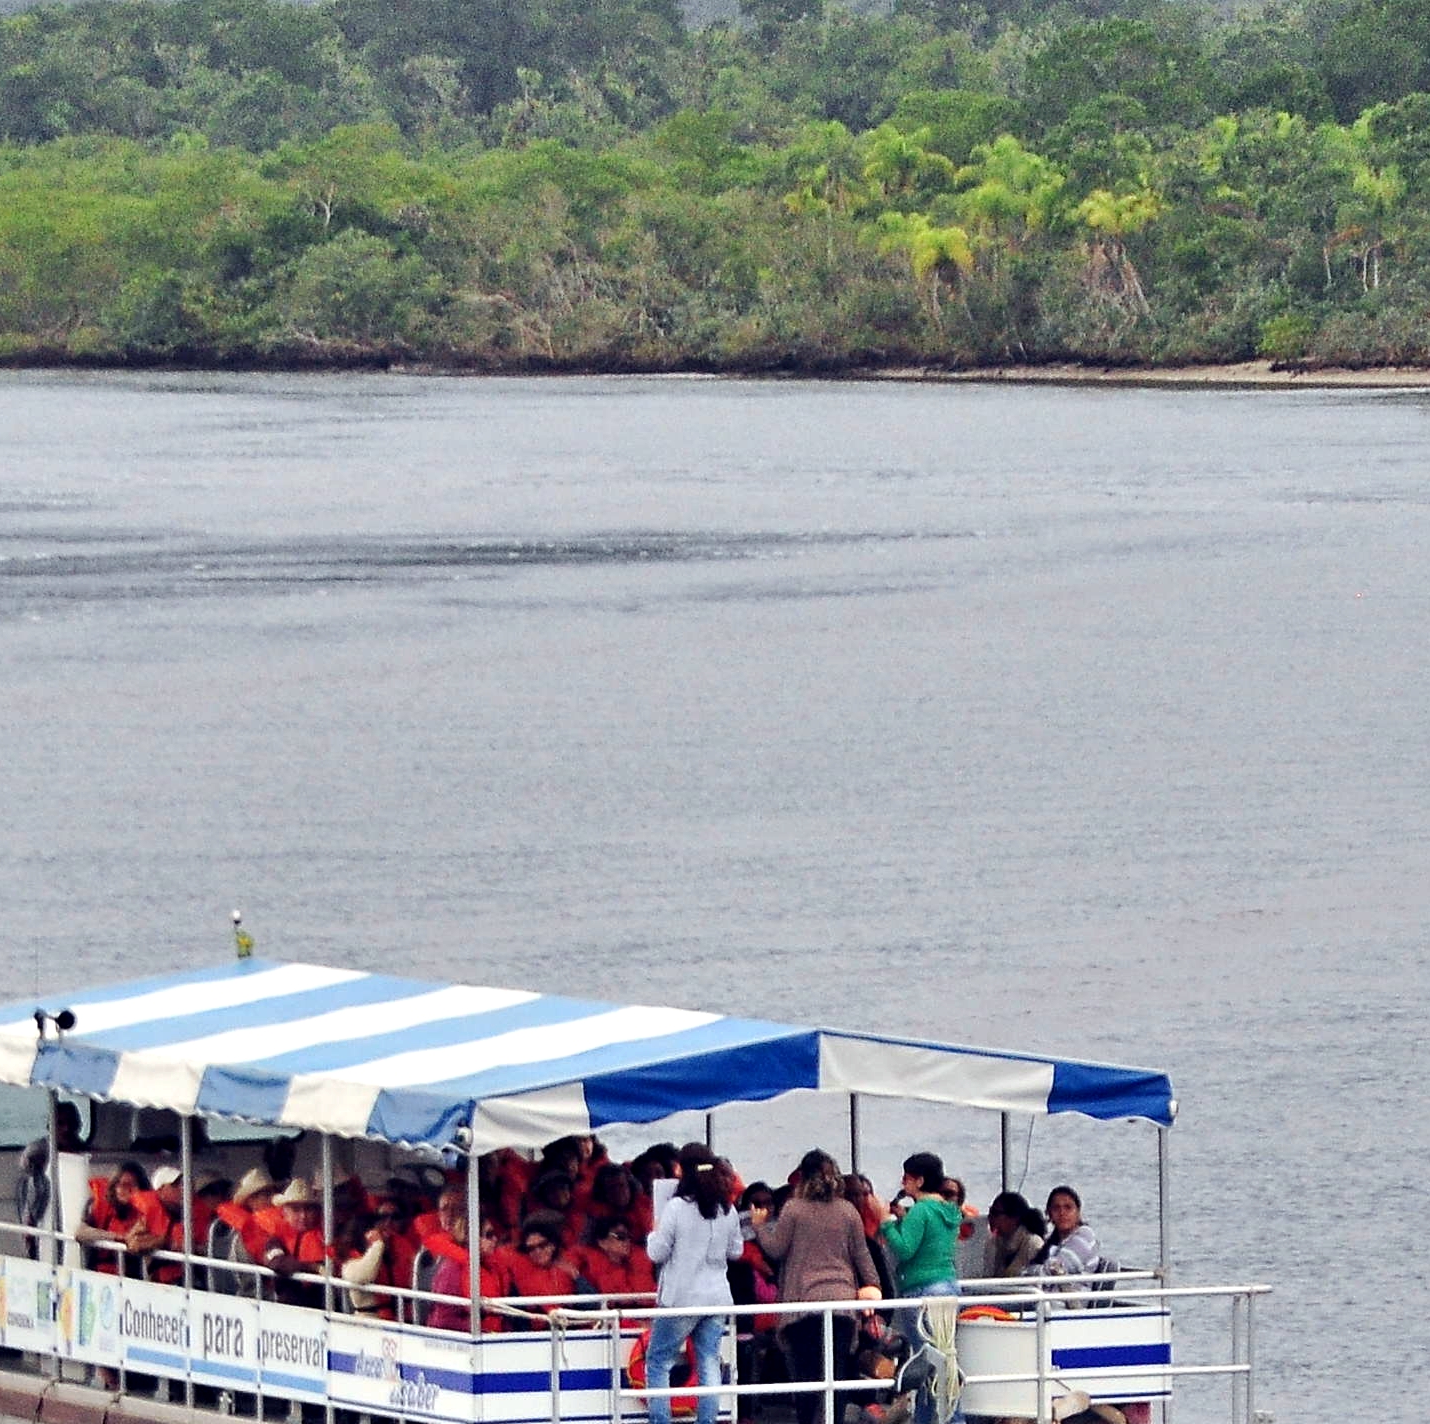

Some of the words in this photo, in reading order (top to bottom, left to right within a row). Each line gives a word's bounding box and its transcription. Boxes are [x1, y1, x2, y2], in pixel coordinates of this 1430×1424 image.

[124, 1299, 187, 1347] Conhecer
[203, 1312, 244, 1360] para
[261, 1329, 327, 1368] preservar
